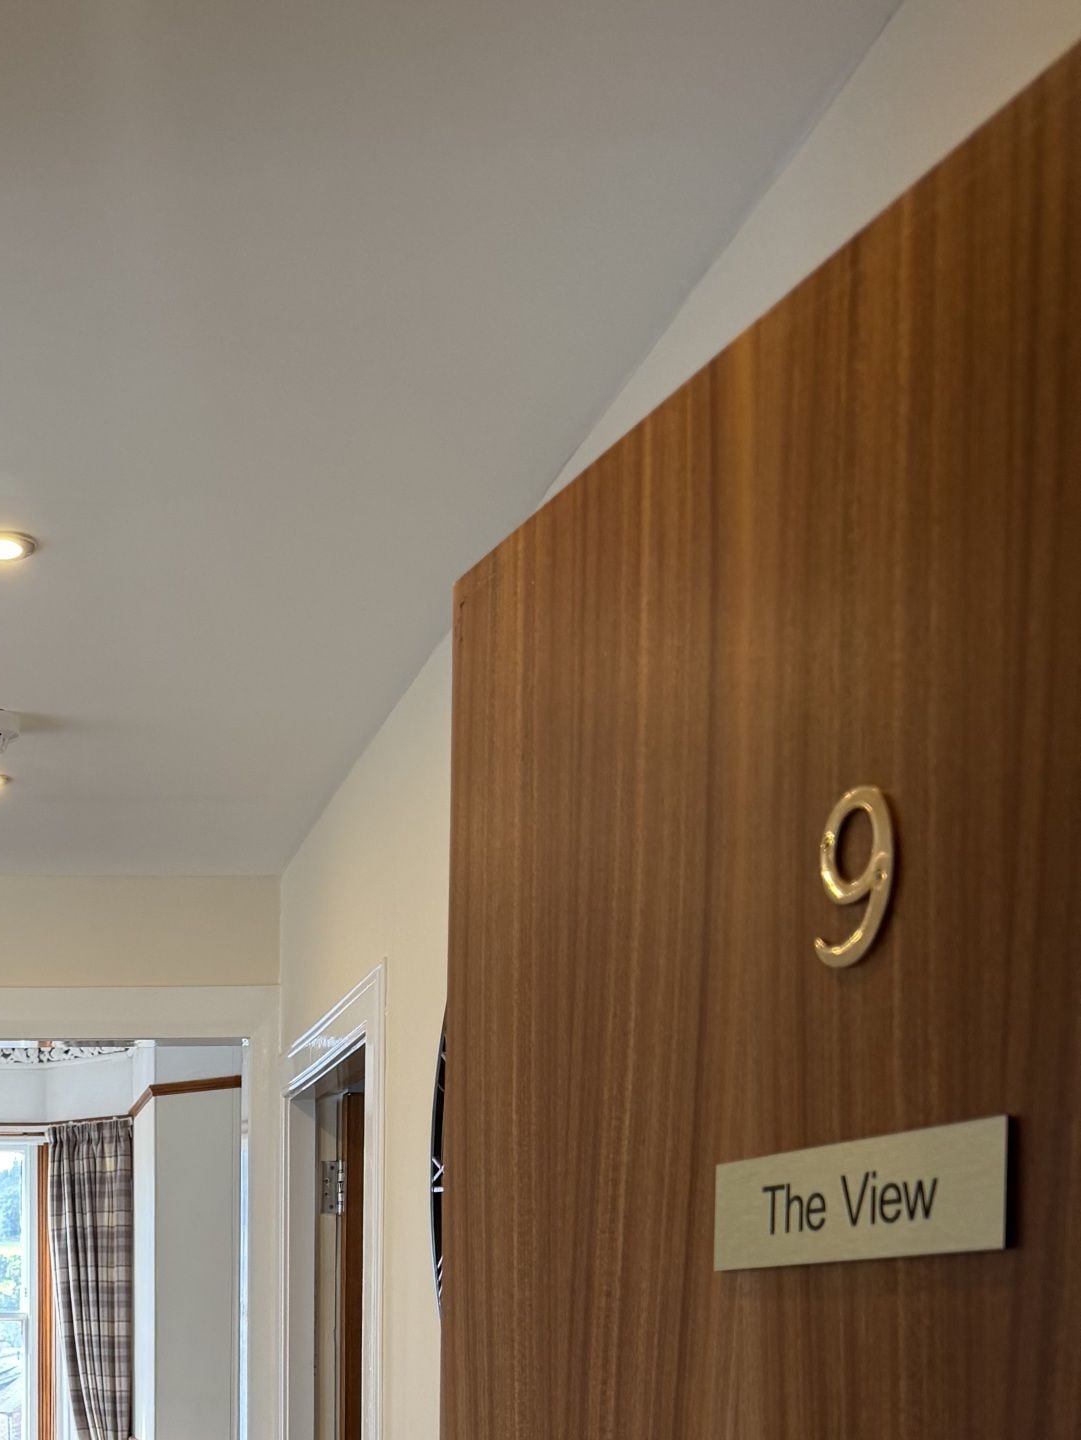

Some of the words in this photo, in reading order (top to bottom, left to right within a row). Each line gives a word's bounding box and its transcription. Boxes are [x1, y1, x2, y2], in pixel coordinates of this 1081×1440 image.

[814, 785, 893, 968] 9
[762, 1183, 826, 1235] The
[840, 1170, 938, 1227] View
